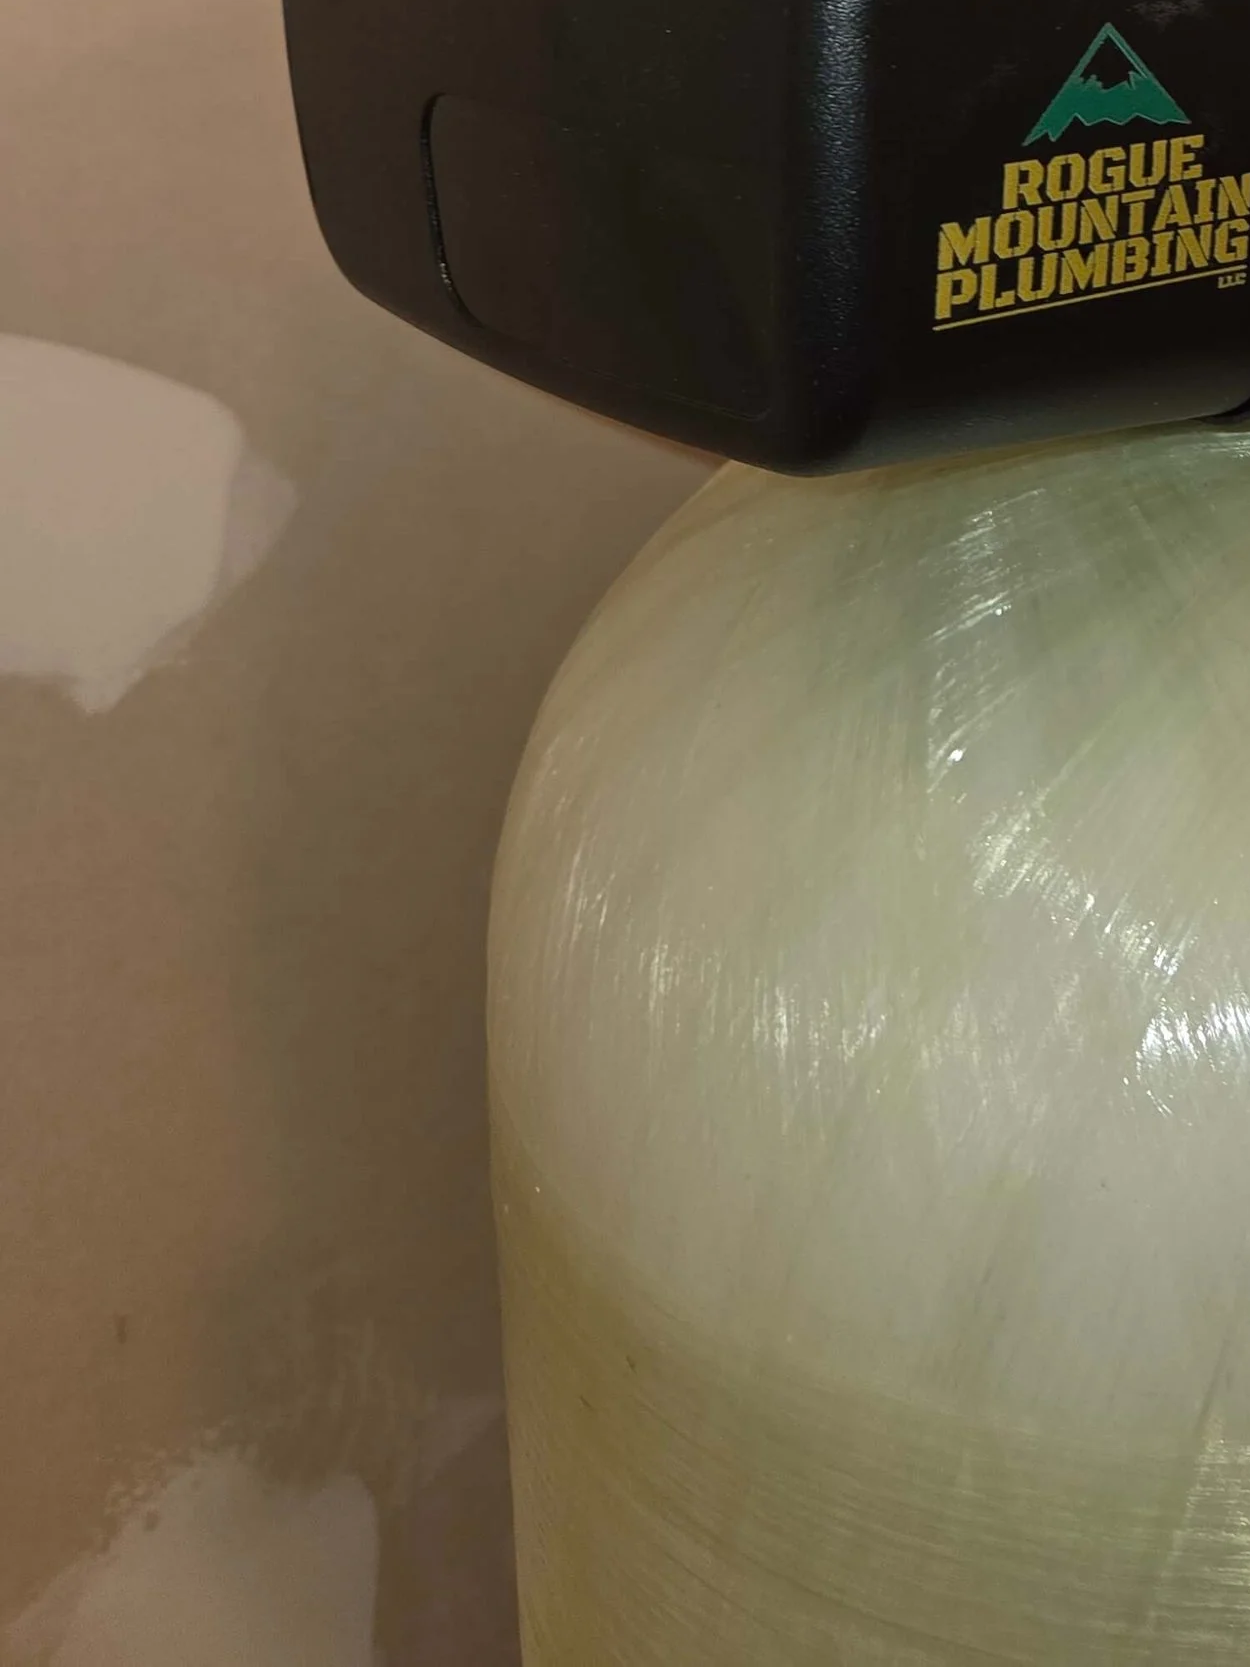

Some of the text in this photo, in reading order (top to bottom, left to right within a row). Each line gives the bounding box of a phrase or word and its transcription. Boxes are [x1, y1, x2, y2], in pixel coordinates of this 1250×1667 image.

[1002, 134, 1205, 210] ROGUE
[934, 218, 1250, 320] PLUMBING
[1217, 272, 1248, 289] LLC
